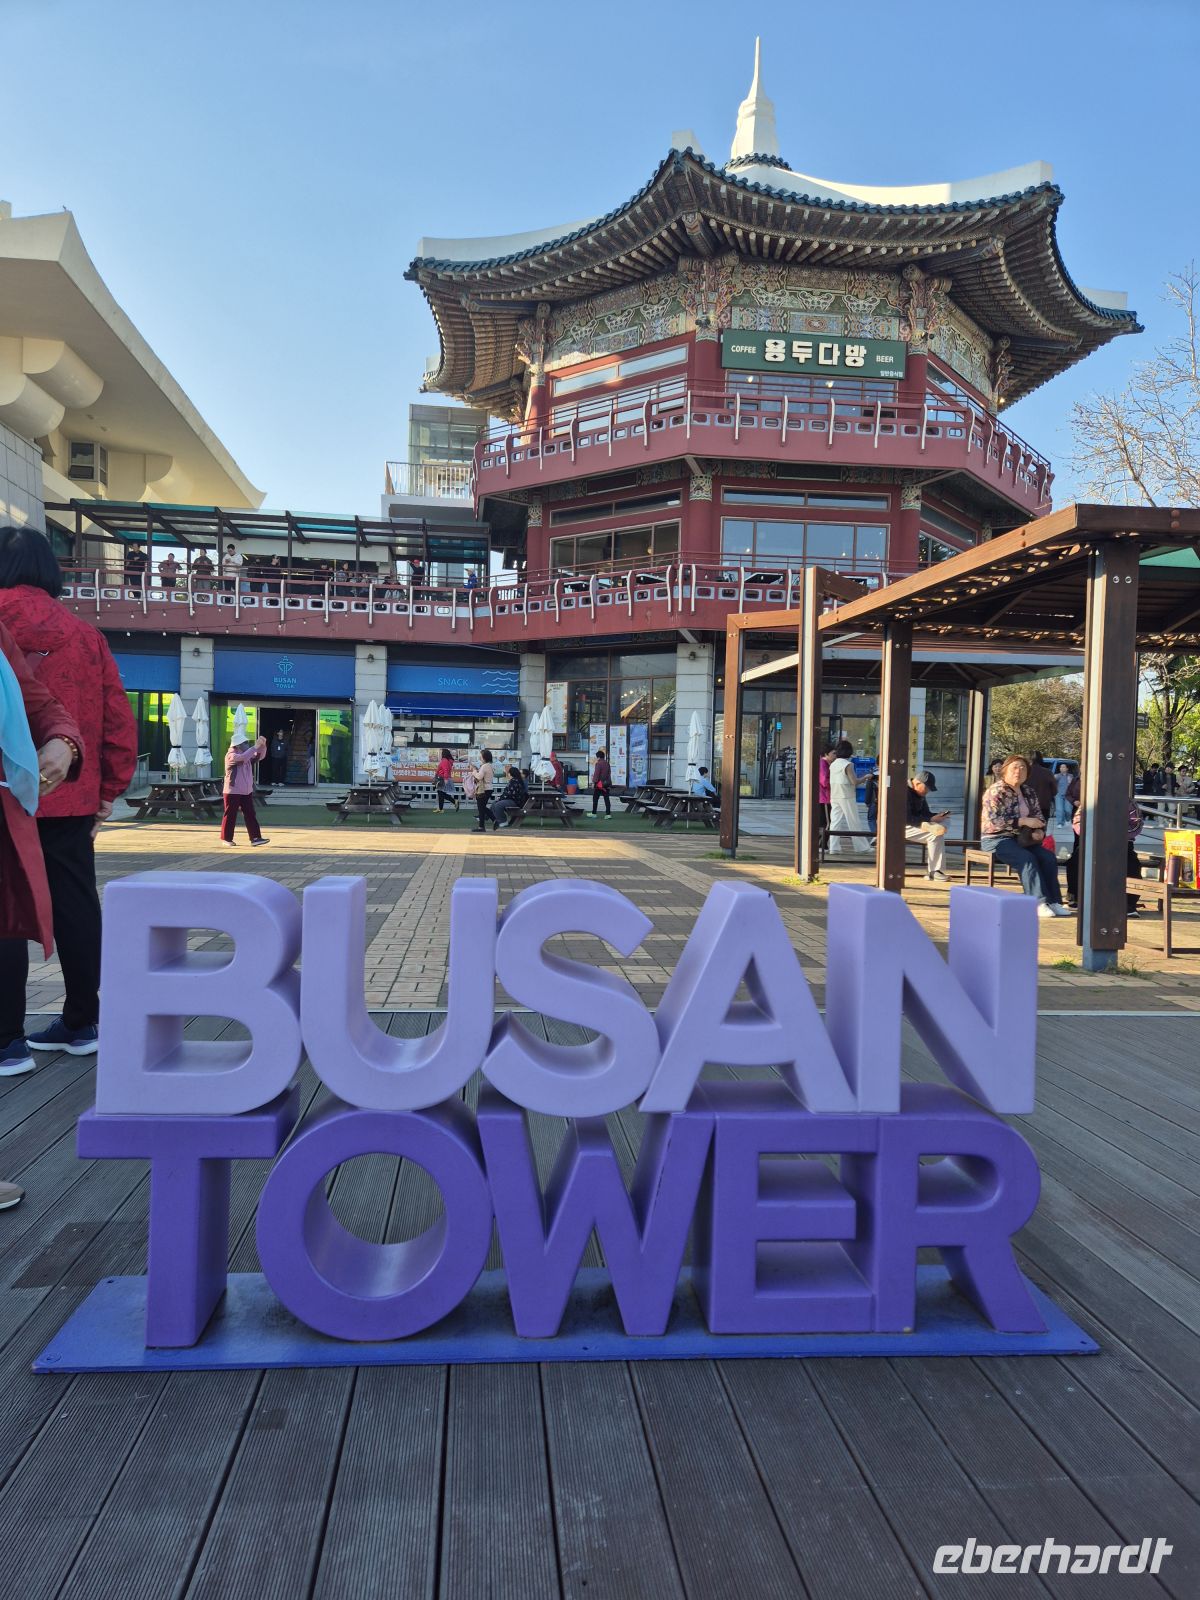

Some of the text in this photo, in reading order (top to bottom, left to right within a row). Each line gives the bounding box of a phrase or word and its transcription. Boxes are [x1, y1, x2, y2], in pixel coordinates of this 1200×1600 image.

[731, 344, 757, 354] COFFEE
[764, 338, 868, 367] 용두다방
[876, 354, 894, 364] BEER
[273, 676, 297, 684] BUSAN
[438, 677, 469, 687] SNACK
[95, 870, 1039, 1118] BUSAN
[77, 1100, 1048, 1350] TOWER
